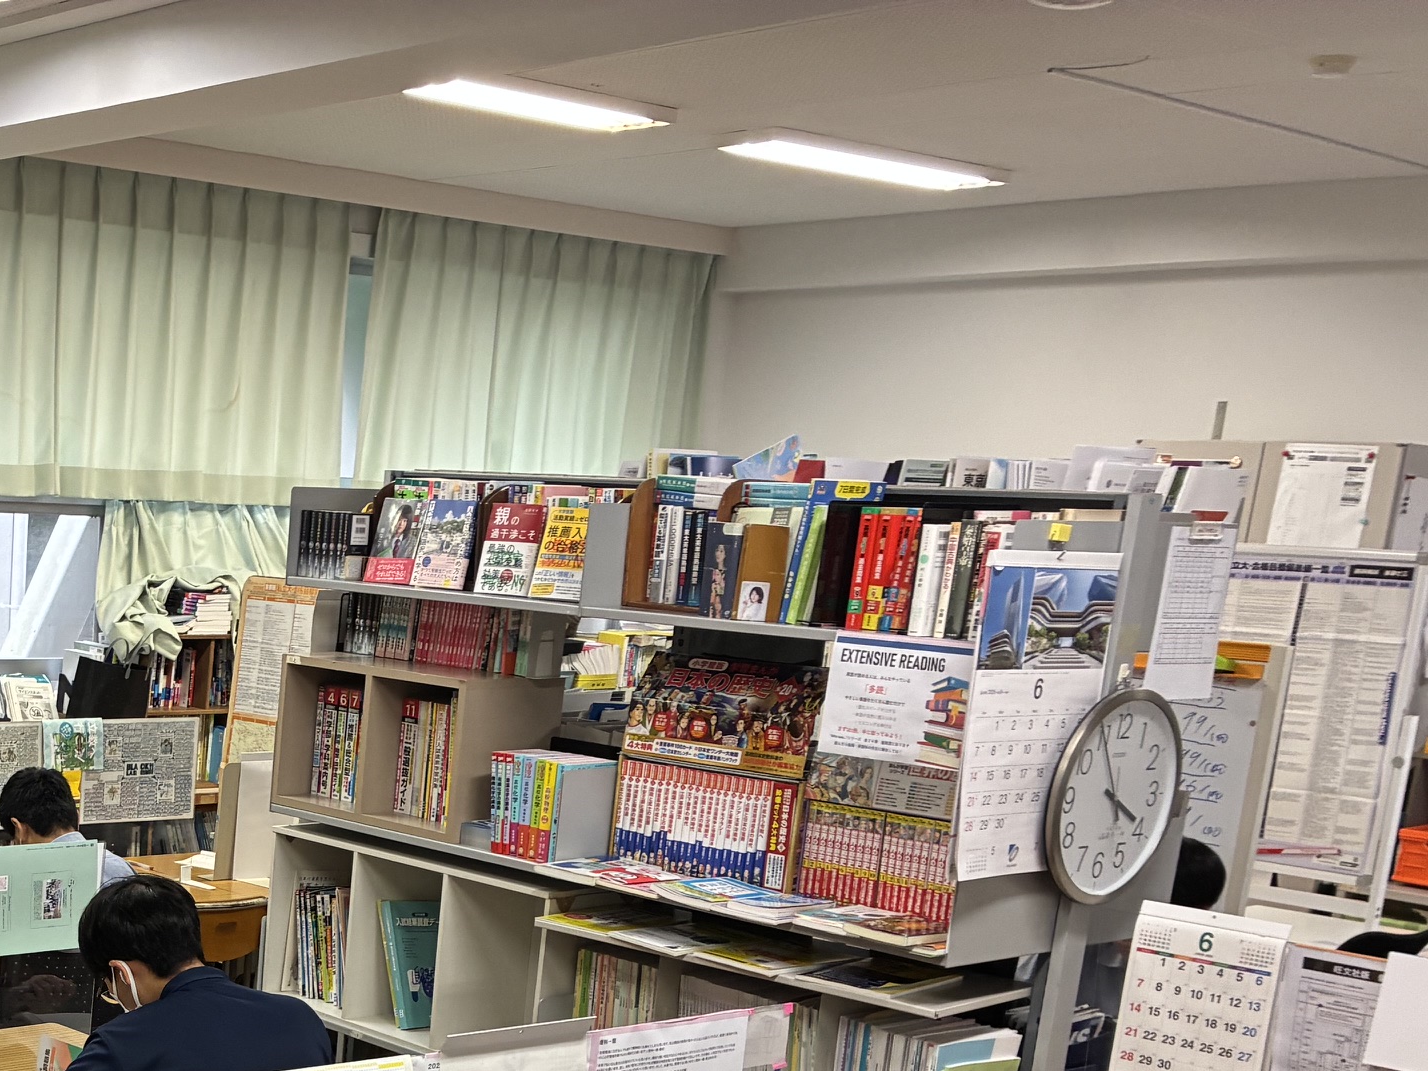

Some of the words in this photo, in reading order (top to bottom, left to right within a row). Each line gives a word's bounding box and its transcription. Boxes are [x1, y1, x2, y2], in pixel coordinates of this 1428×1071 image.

[494, 507, 520, 525] 親の
[490, 528, 535, 540] 過干渉こそ
[841, 648, 897, 667] EXTENSIVE
[899, 654, 946, 672] READING
[666, 669, 772, 698] 日本の歴史
[1034, 678, 1044, 699] 6
[328, 693, 335, 703] 4
[340, 694, 347, 705] 6
[352, 695, 359, 707] 7
[406, 705, 415, 717] 11
[1098, 725, 1111, 750] 11
[1117, 713, 1133, 739] 12
[1140, 723, 1147, 749] 1
[1076, 749, 1093, 775] 10
[1146, 744, 1159, 771] 2
[1062, 786, 1075, 813] 9
[1146, 781, 1158, 807] 3
[1063, 822, 1076, 849] 8
[1132, 817, 1144, 837] 4
[1076, 845, 1088, 872] 7
[1092, 852, 1104, 878] 6
[1113, 842, 1126, 868] 5
[1199, 932, 1214, 952] 6
[1161, 958, 1166, 967] 1
[1178, 961, 1186, 971] 2
[1197, 964, 1205, 974] 3
[1216, 968, 1224, 978] 4
[1236, 972, 1244, 982] 5
[1256, 976, 1263, 986] 6
[1137, 978, 1145, 987] 7
[1155, 982, 1163, 992] 8
[1174, 986, 1182, 996] 9
[1190, 989, 1203, 1000] 10
[1210, 993, 1222, 1004] 11
[1229, 997, 1242, 1008] 12
[1248, 1001, 1261, 1012] 13
[1130, 1002, 1141, 1013] 14
[1148, 1006, 1161, 1017] 15
[1167, 1010, 1180, 1021] 16
[1186, 1014, 1199, 1024] 17
[1205, 1018, 1218, 1029] 18
[1224, 1022, 1237, 1033] 19
[1242, 1026, 1257, 1038] 20
[1124, 1026, 1138, 1038] 21
[1142, 1030, 1157, 1042] 22
[1161, 1034, 1176, 1046] 23
[1180, 1038, 1194, 1050] 24
[1199, 1042, 1214, 1054] 25
[1218, 1047, 1233, 1058] 26
[1237, 1051, 1252, 1062] 27
[1120, 1050, 1134, 1062] 28
[1138, 1054, 1152, 1066] 29
[1157, 1059, 1171, 1070] 30
